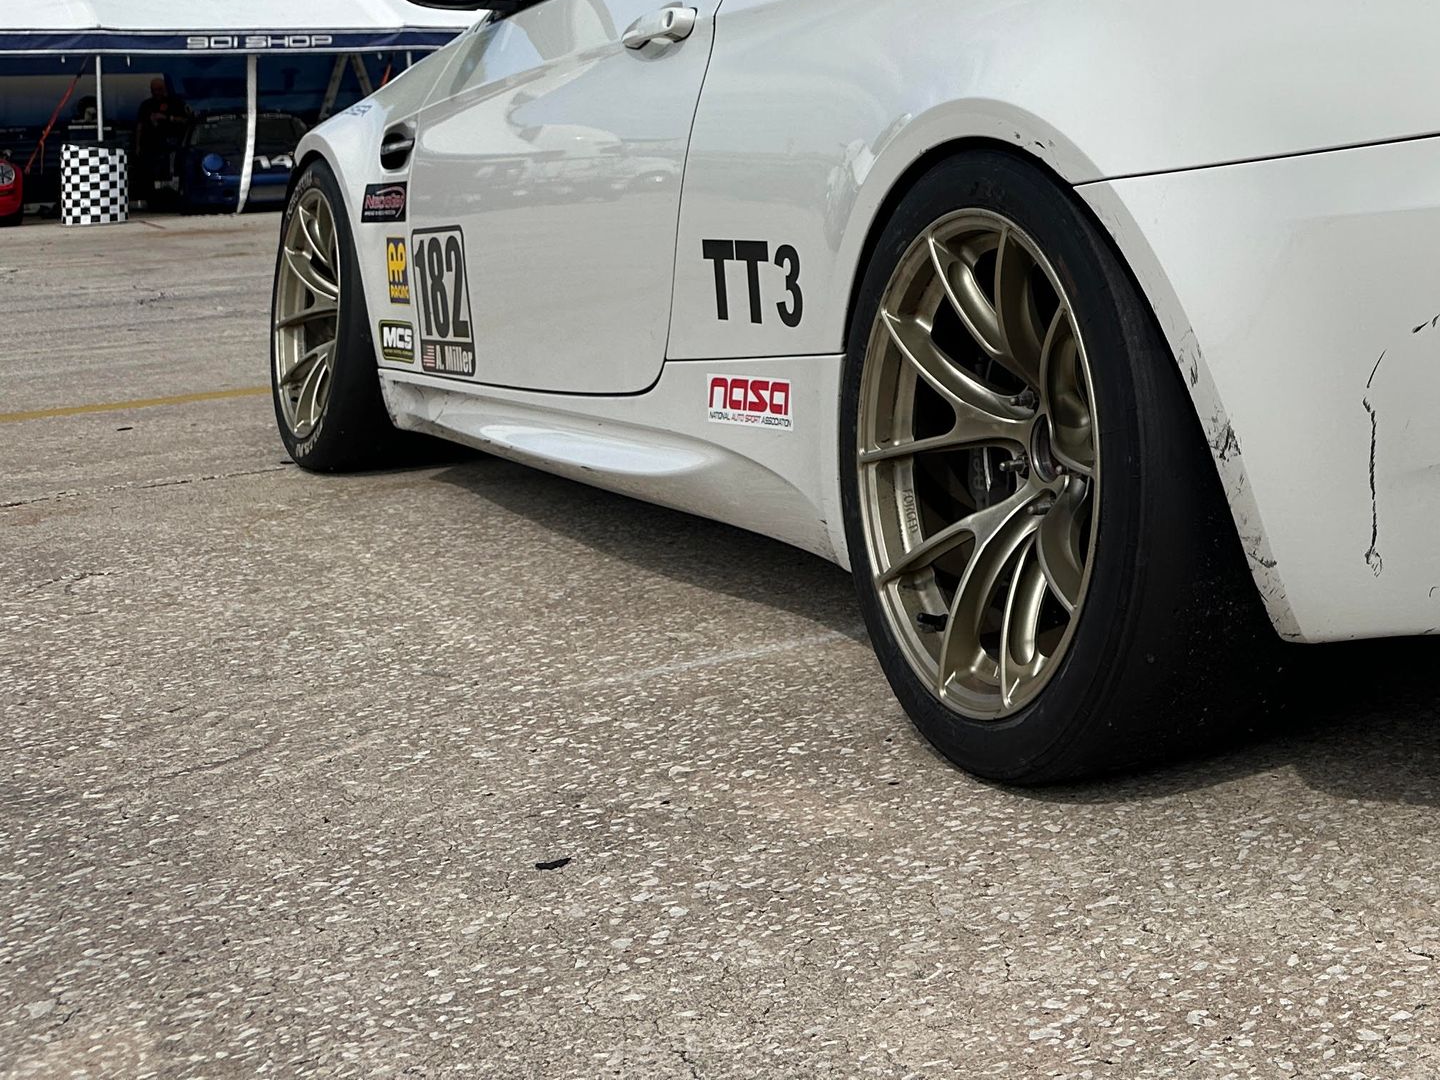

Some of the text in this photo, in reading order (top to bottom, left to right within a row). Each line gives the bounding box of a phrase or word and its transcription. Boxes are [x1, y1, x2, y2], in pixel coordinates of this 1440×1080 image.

[245, 35, 333, 48] SHOP
[388, 242, 407, 282] AP
[391, 284, 410, 299] RACING
[414, 235, 470, 339] 182
[702, 239, 803, 328] TT3
[383, 326, 413, 350] MCS
[435, 344, 473, 373] A. Miller
